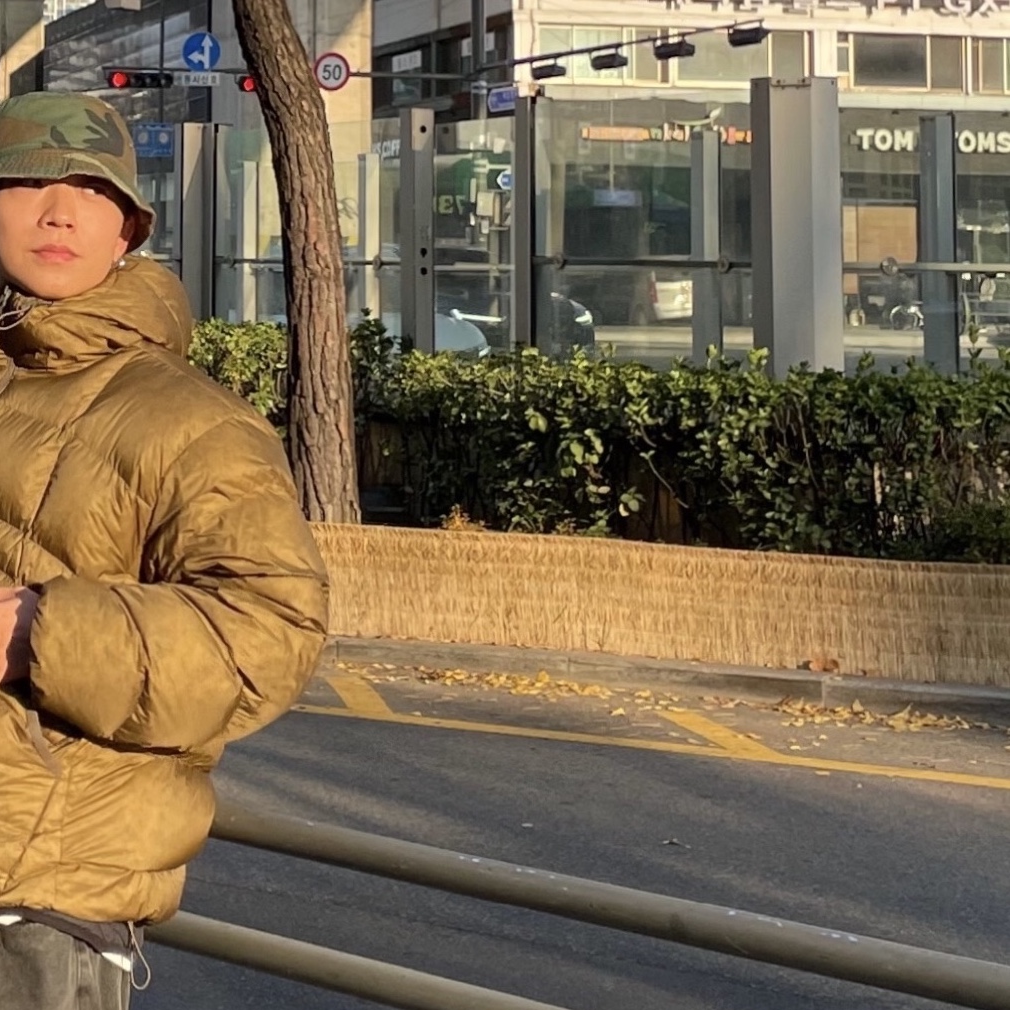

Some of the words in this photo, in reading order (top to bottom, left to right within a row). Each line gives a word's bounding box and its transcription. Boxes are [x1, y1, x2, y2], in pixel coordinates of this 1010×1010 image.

[322, 64, 342, 81] 50
[856, 128, 914, 151] TOM
[954, 129, 1010, 153] OMS
